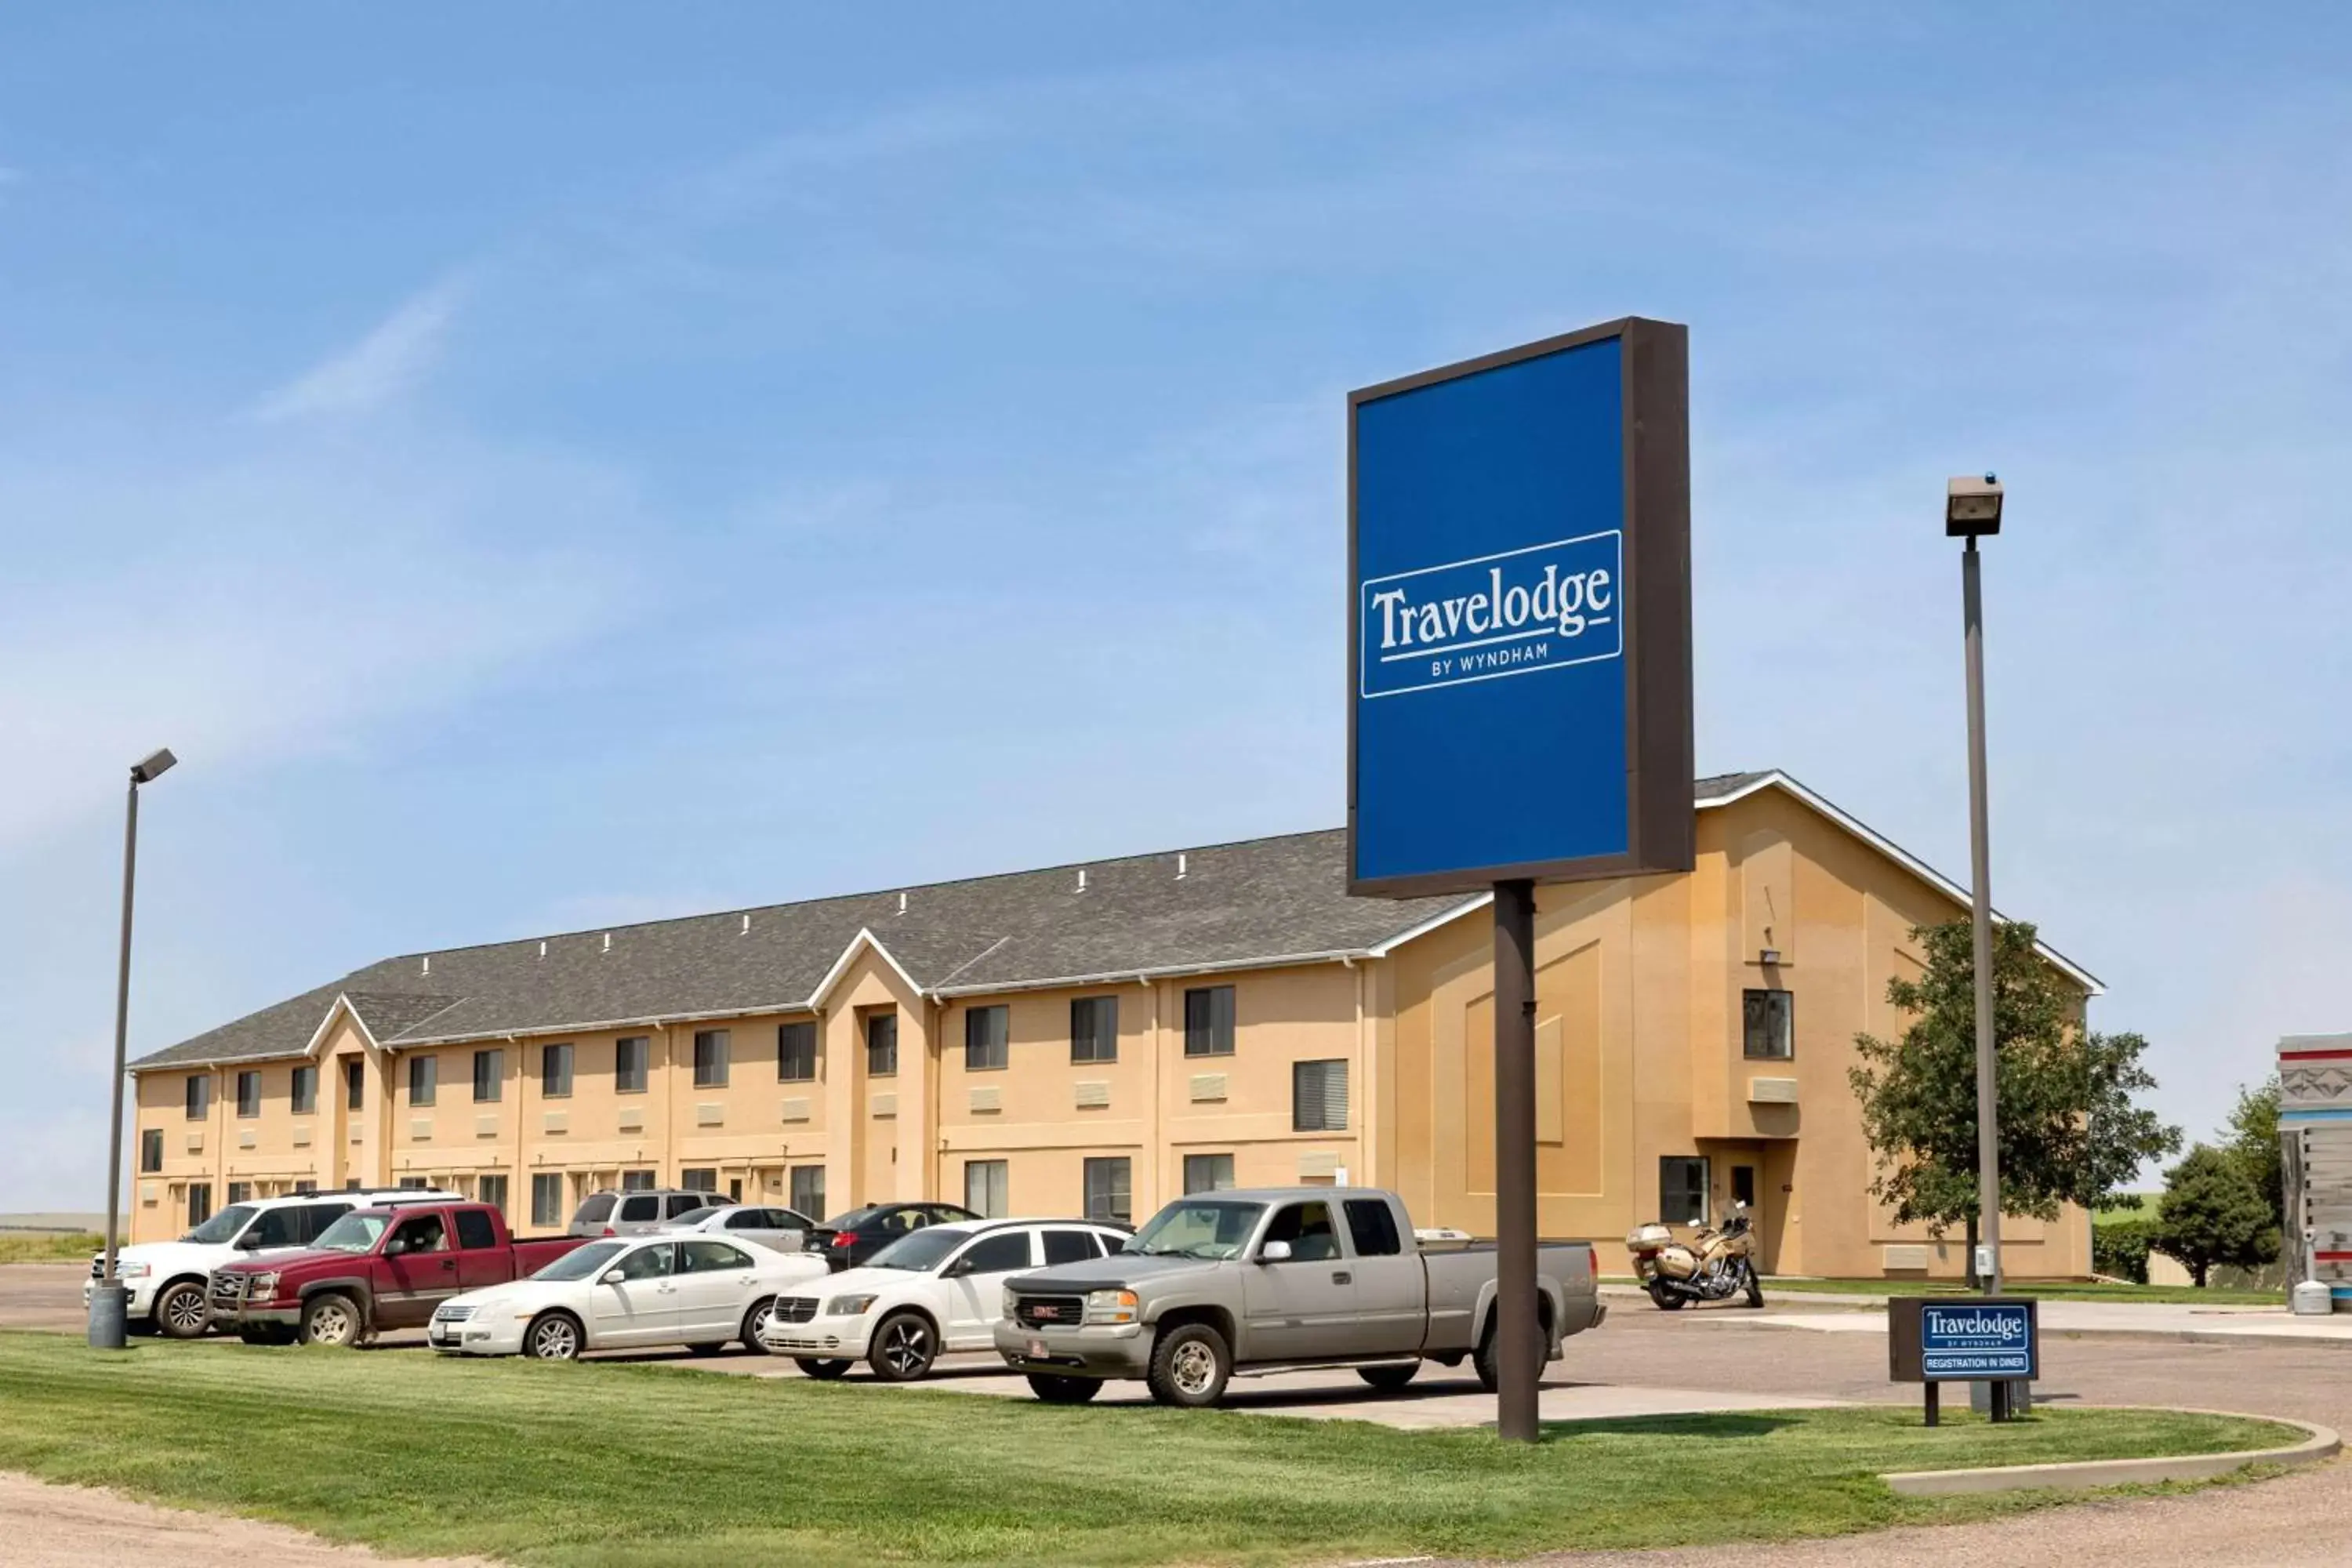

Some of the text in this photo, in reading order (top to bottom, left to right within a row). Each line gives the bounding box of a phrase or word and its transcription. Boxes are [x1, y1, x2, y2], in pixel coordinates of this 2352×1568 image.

[1371, 564, 1611, 648] Travelodge
[1432, 642, 1548, 677] BY WYNDHAM
[1927, 1309, 2022, 1341] Travelodge
[1926, 1356, 2024, 1369] REGISTRATION IN DINER
